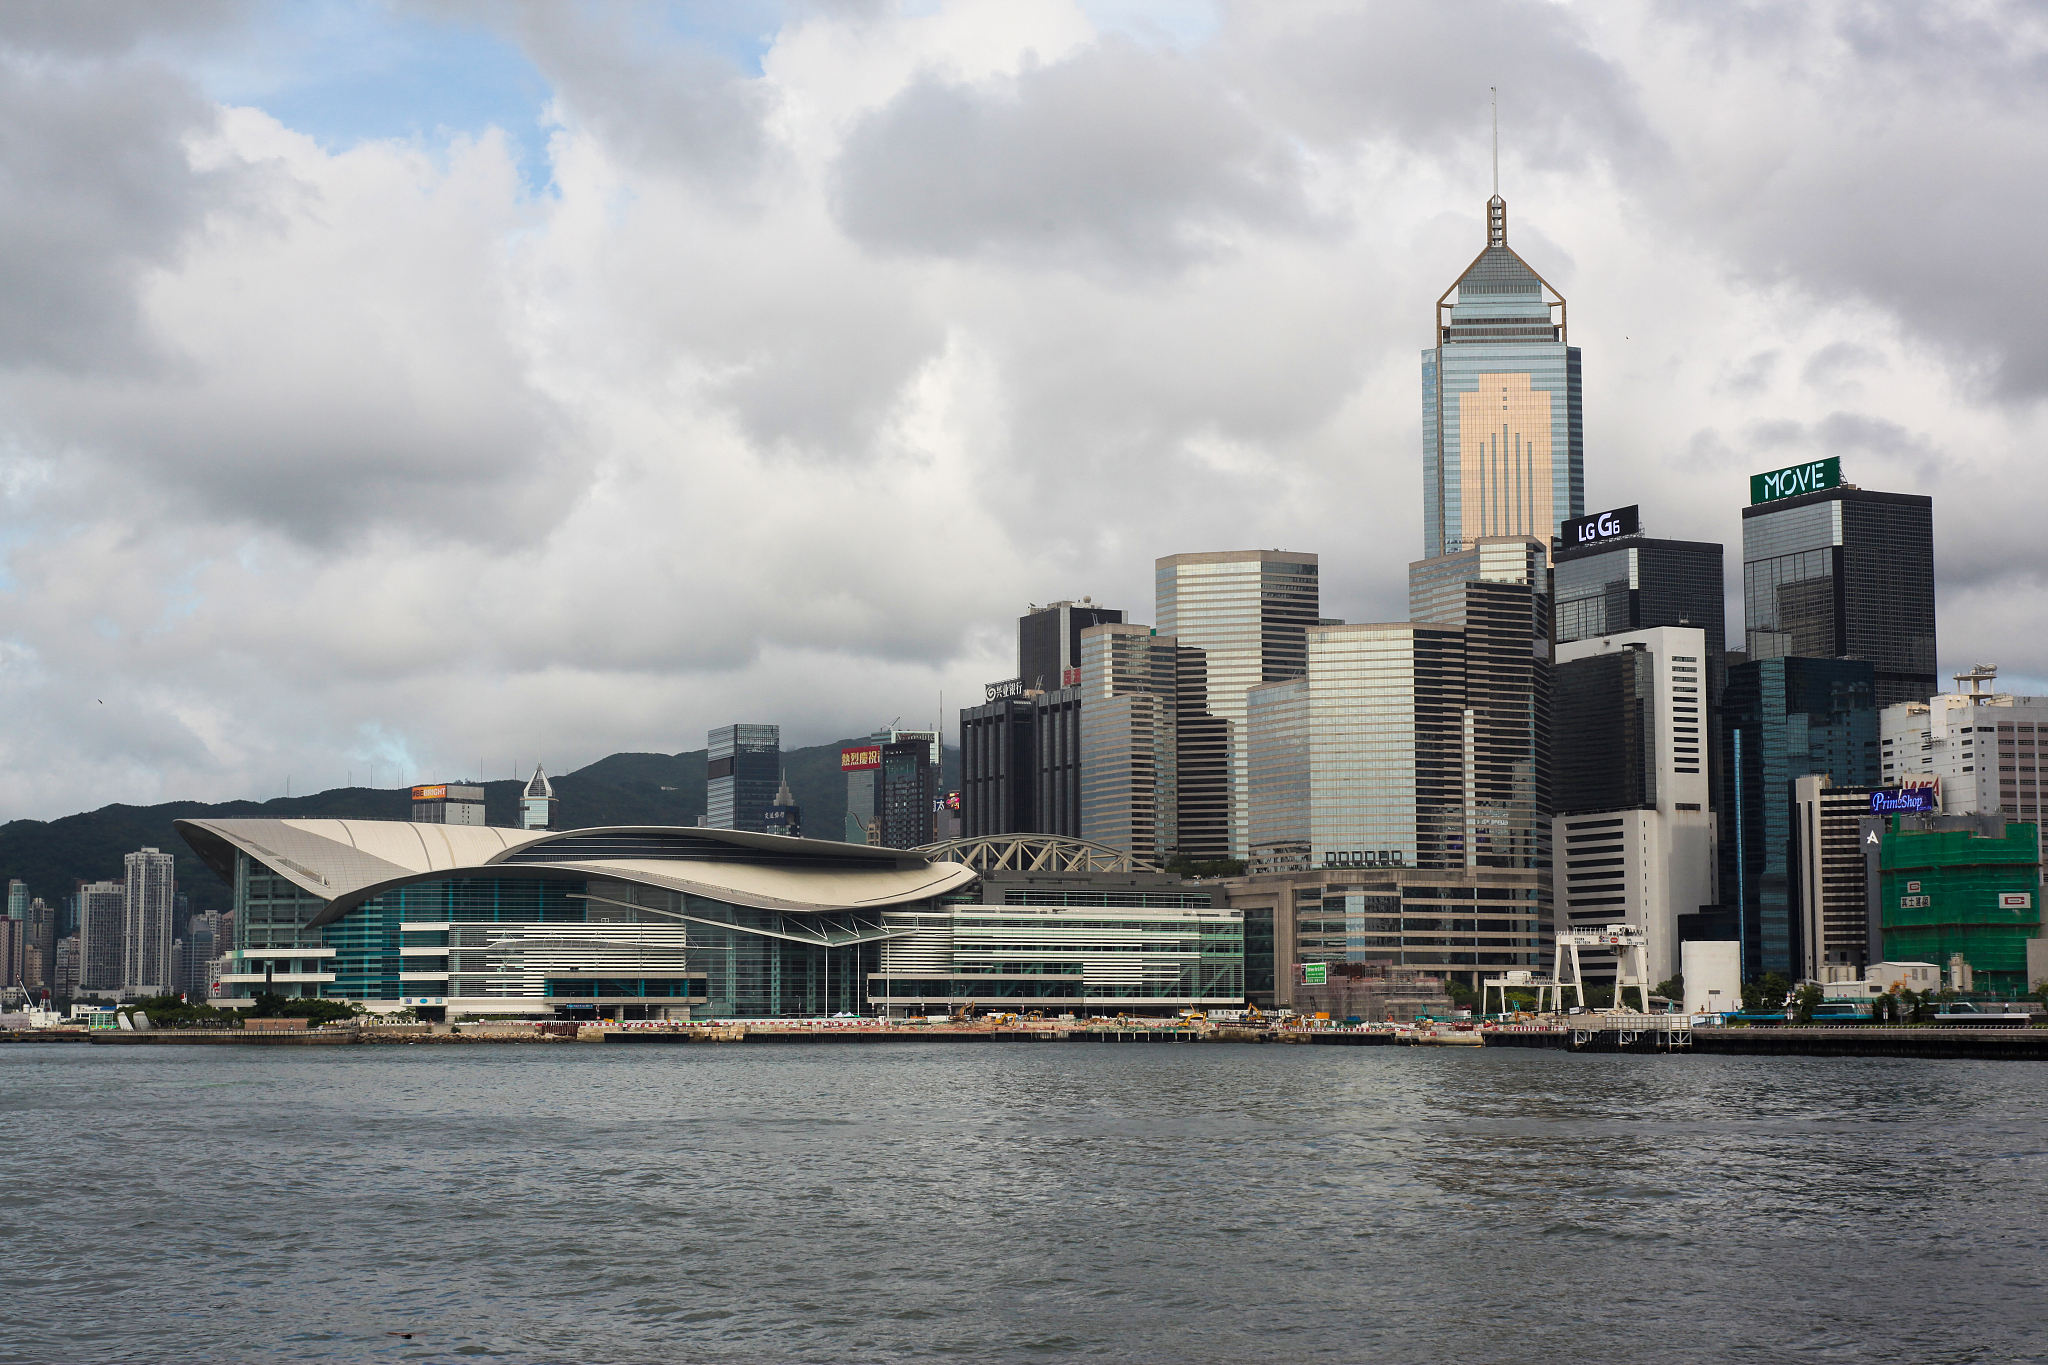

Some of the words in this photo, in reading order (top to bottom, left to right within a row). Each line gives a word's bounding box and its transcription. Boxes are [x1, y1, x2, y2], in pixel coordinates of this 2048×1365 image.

[1764, 462, 1825, 500] MOVE
[1578, 522, 1596, 543] LG
[1597, 512, 1620, 537] G6
